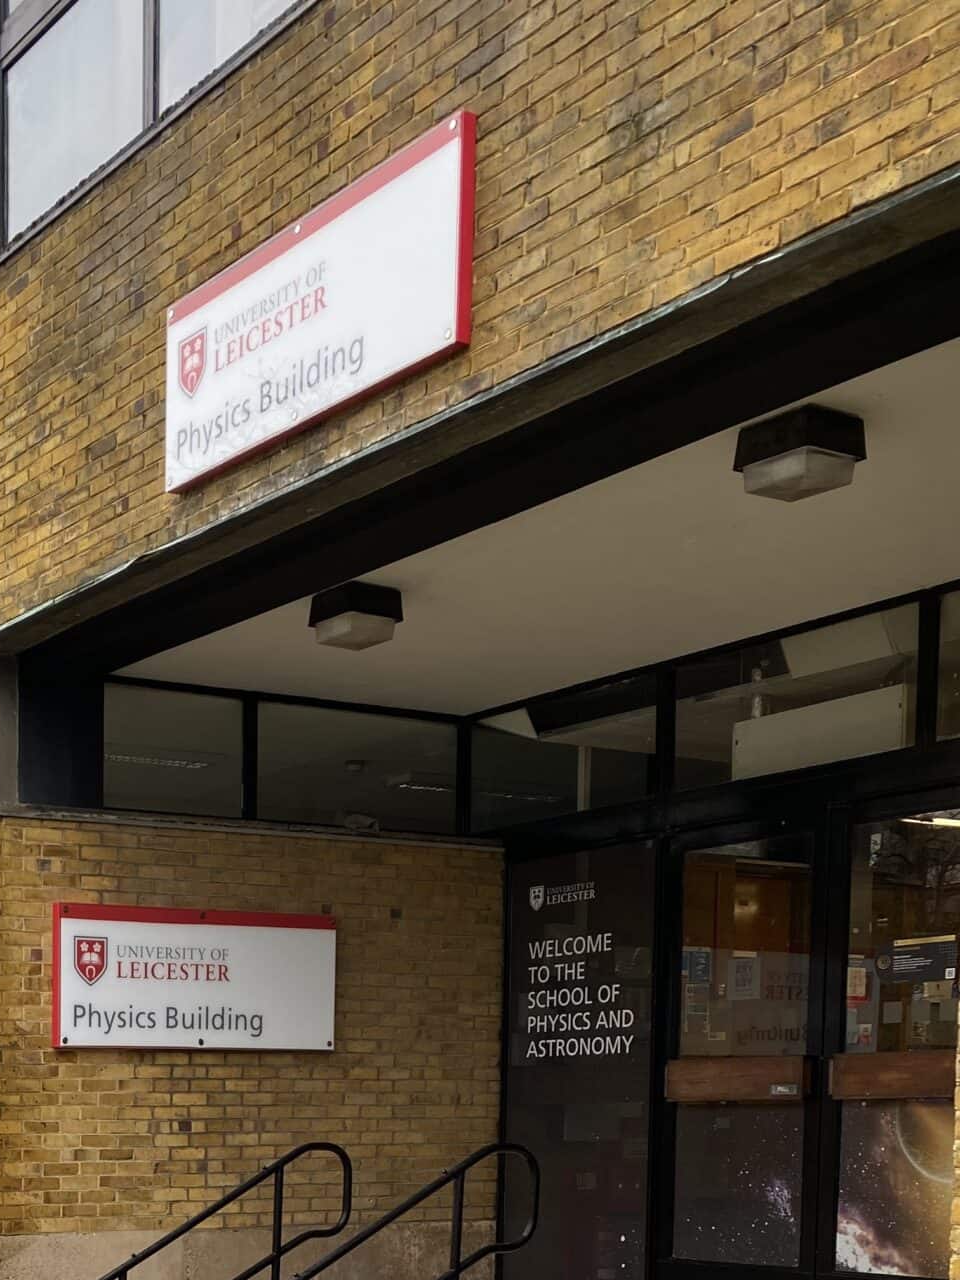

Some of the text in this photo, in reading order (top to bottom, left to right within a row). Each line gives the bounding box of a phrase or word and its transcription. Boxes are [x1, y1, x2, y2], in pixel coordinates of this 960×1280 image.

[214, 261, 328, 345] UNIVERSITY OF
[213, 285, 328, 372] LEICESTER
[176, 335, 365, 460] Physics Building
[546, 889, 596, 905] LEICESTER
[547, 884, 585, 894] UNIVERSITY
[116, 944, 230, 961] UNIVERSITY OF
[528, 933, 613, 959] WELCOME
[116, 961, 231, 982] LEICESTER
[528, 962, 585, 984] TO THE
[527, 984, 621, 1009] SCHOOL OF
[73, 1003, 264, 1037] Physics Building
[527, 1009, 634, 1033] PHYSICS AND
[526, 1035, 634, 1058] ASTRONOMY
